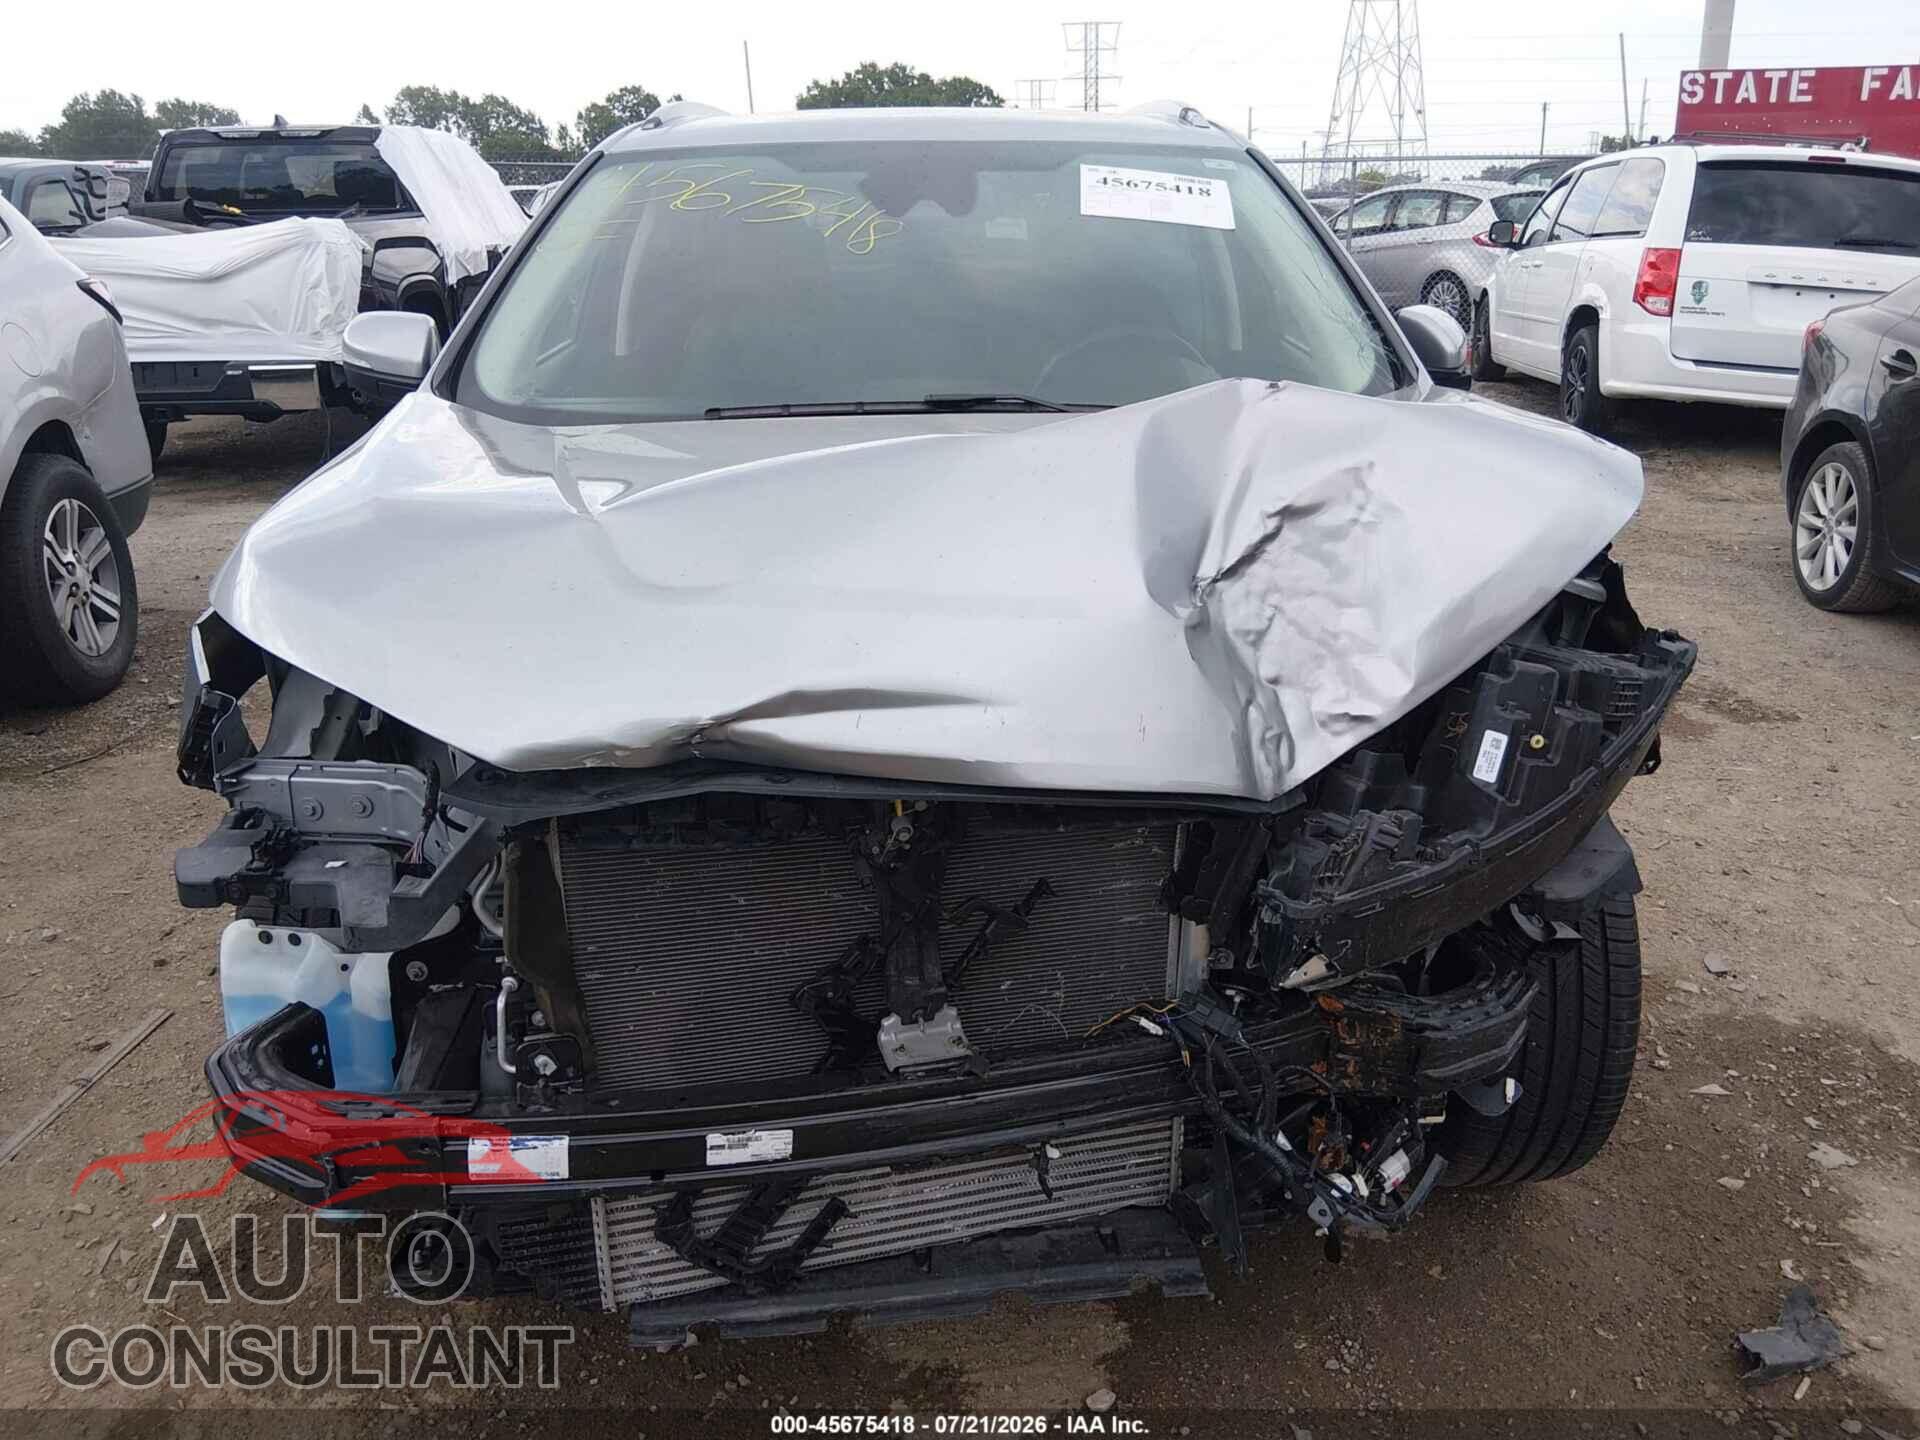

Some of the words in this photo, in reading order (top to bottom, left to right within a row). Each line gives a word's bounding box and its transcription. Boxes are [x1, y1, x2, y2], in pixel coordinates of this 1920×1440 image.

[1680, 68, 1817, 105] STATE
[1860, 66, 1920, 102] FA
[1096, 176, 1213, 198] 45675418
